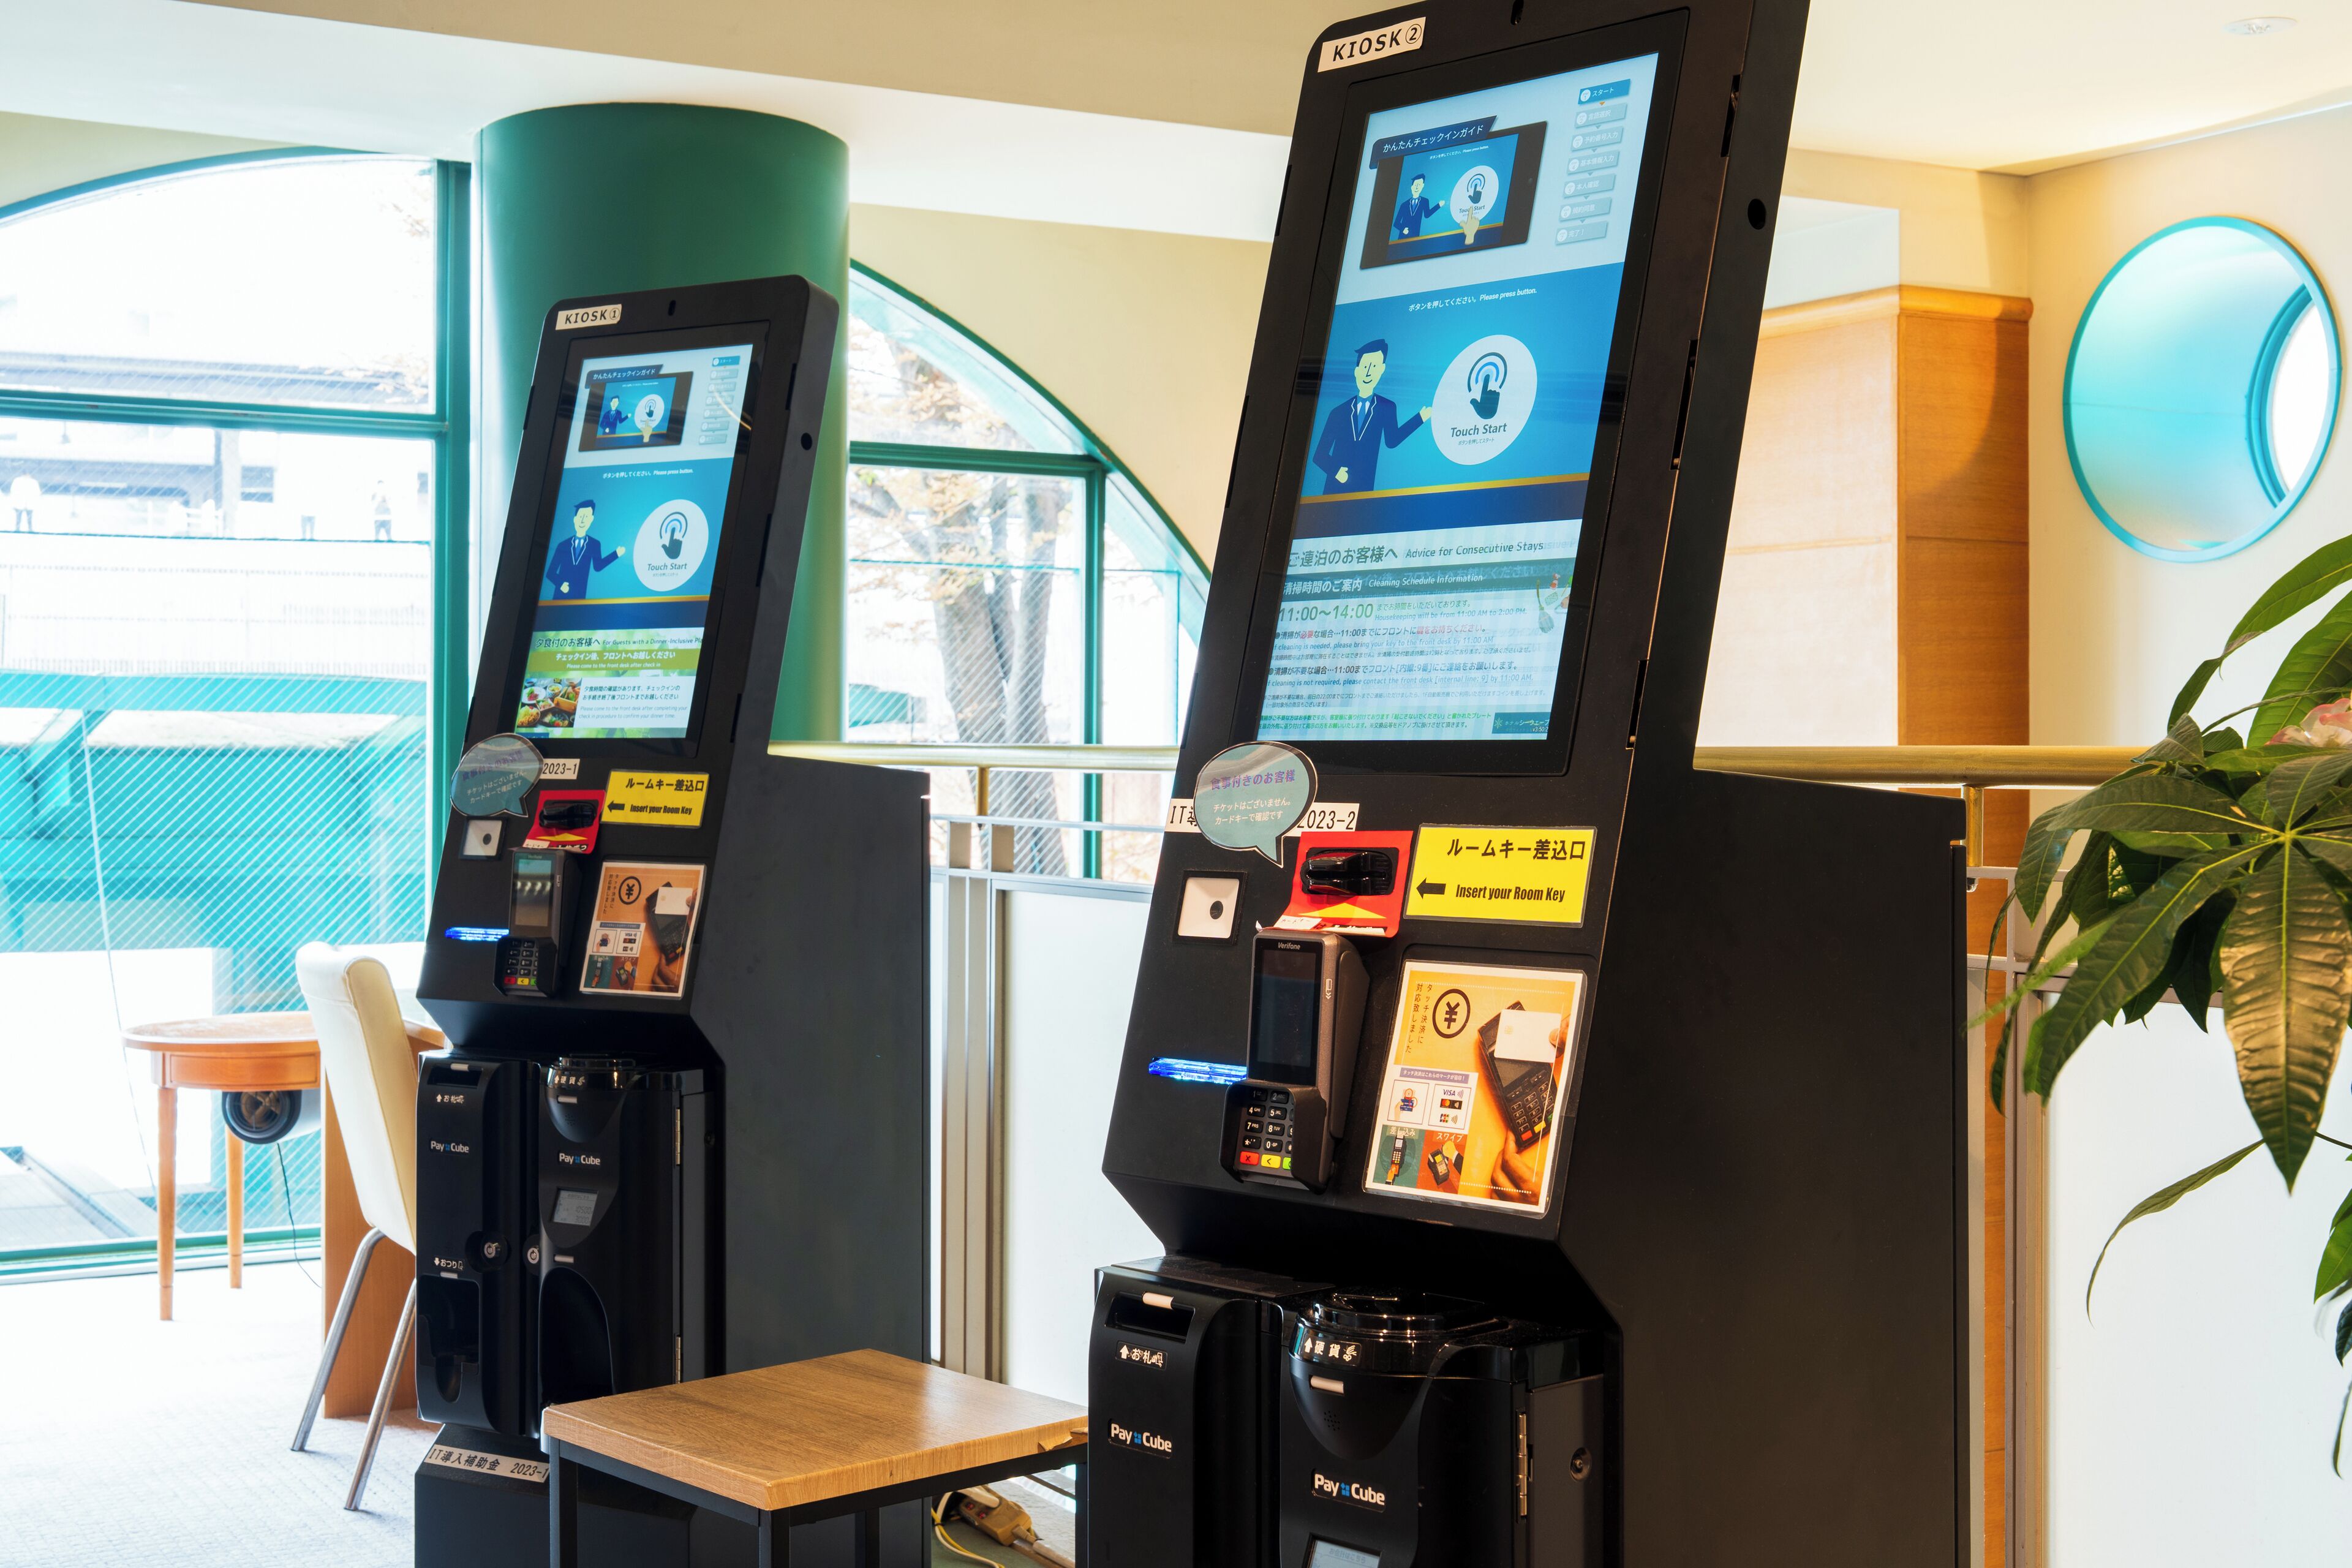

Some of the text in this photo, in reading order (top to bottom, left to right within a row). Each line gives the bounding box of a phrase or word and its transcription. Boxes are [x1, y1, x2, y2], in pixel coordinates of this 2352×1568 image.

[1592, 88, 1614, 97] スタート
[1383, 125, 1484, 153] かんたんチェックインガイド
[1409, 296, 1477, 312] ボタンを押してください。
[593, 369, 655, 380] かんたんチェックインガイド
[1451, 423, 1507, 437] Touch Start
[1288, 545, 1398, 567] ご連泊のお客様へ
[1406, 548, 1434, 558] Advice
[1439, 547, 1453, 556] for
[1456, 543, 1513, 555] Consecutive
[1517, 541, 1544, 552] Stays
[647, 562, 668, 571] Touch
[1283, 578, 1363, 595] 清掃時間のご案内
[1369, 578, 1400, 588] Cleaning
[1402, 575, 1434, 586] Schedule
[1437, 573, 1483, 584] Information
[1378, 600, 1471, 611] までお時間をいただいております。
[1375, 612, 1416, 621] Housekeeping
[536, 638, 600, 647] 夕食付のお客様へ
[1333, 642, 1352, 650] please
[556, 651, 676, 660] チェックイン後、フロントへお越しください
[1315, 678, 1341, 687] required,
[1343, 678, 1362, 687] please
[543, 763, 577, 774] 2023-1
[625, 778, 704, 791] ルームキー差込口
[1210, 769, 1295, 790] 食事付きのお客様
[470, 780, 522, 804] カードキーで確認です
[630, 804, 648, 813] Insert
[663, 805, 679, 814] Room
[681, 806, 692, 815] Key
[1213, 797, 1291, 813] チケットはございません。
[1215, 810, 1283, 825] カードキーで確認です
[1447, 839, 1586, 860] ルームキー差込口
[1456, 884, 1565, 902] Insert your Room Key
[1406, 983, 1423, 1053] 対応致しました
[1418, 984, 1433, 1043] タッチ決済に
[1437, 1133, 1464, 1142] スワイプ
[431, 1141, 469, 1153] Pay Cube
[559, 1153, 600, 1165] Pay Cube
[440, 1259, 457, 1268] おつり
[1132, 1348, 1152, 1364] お札
[1314, 1341, 1340, 1358] 硬貨
[1110, 1423, 1172, 1453] Pay Cube
[429, 1448, 549, 1479] IT導入補助金 2023-1
[1314, 1473, 1385, 1506] Pay Cube
